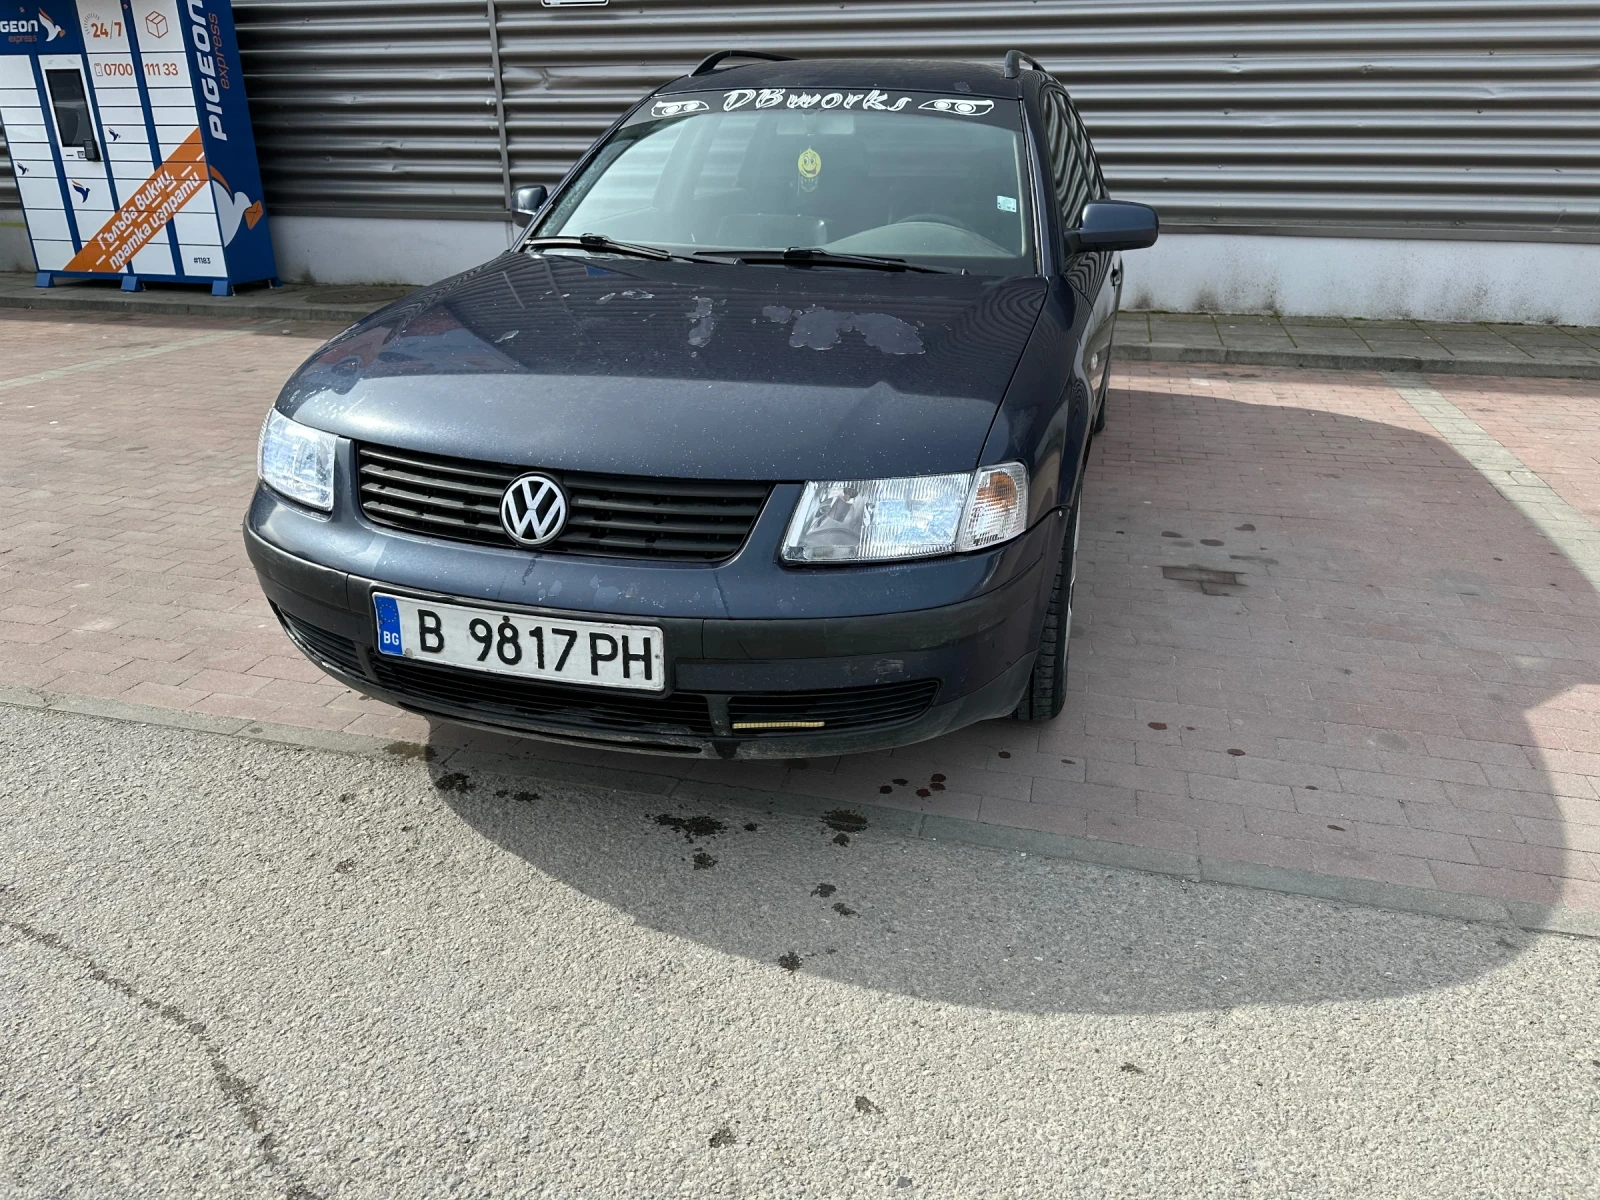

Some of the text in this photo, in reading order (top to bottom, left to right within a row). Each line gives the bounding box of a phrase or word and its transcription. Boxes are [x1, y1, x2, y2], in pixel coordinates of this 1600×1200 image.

[90, 20, 123, 39] 24/7
[208, 12, 230, 89] express
[103, 62, 179, 76] 0700 111 33
[186, 0, 228, 141] PIGEON
[96, 206, 139, 251] Гълъба
[109, 171, 201, 270] пратка изпрати
[383, 630, 400, 646] BG
[417, 608, 653, 681] B 9817 PH
